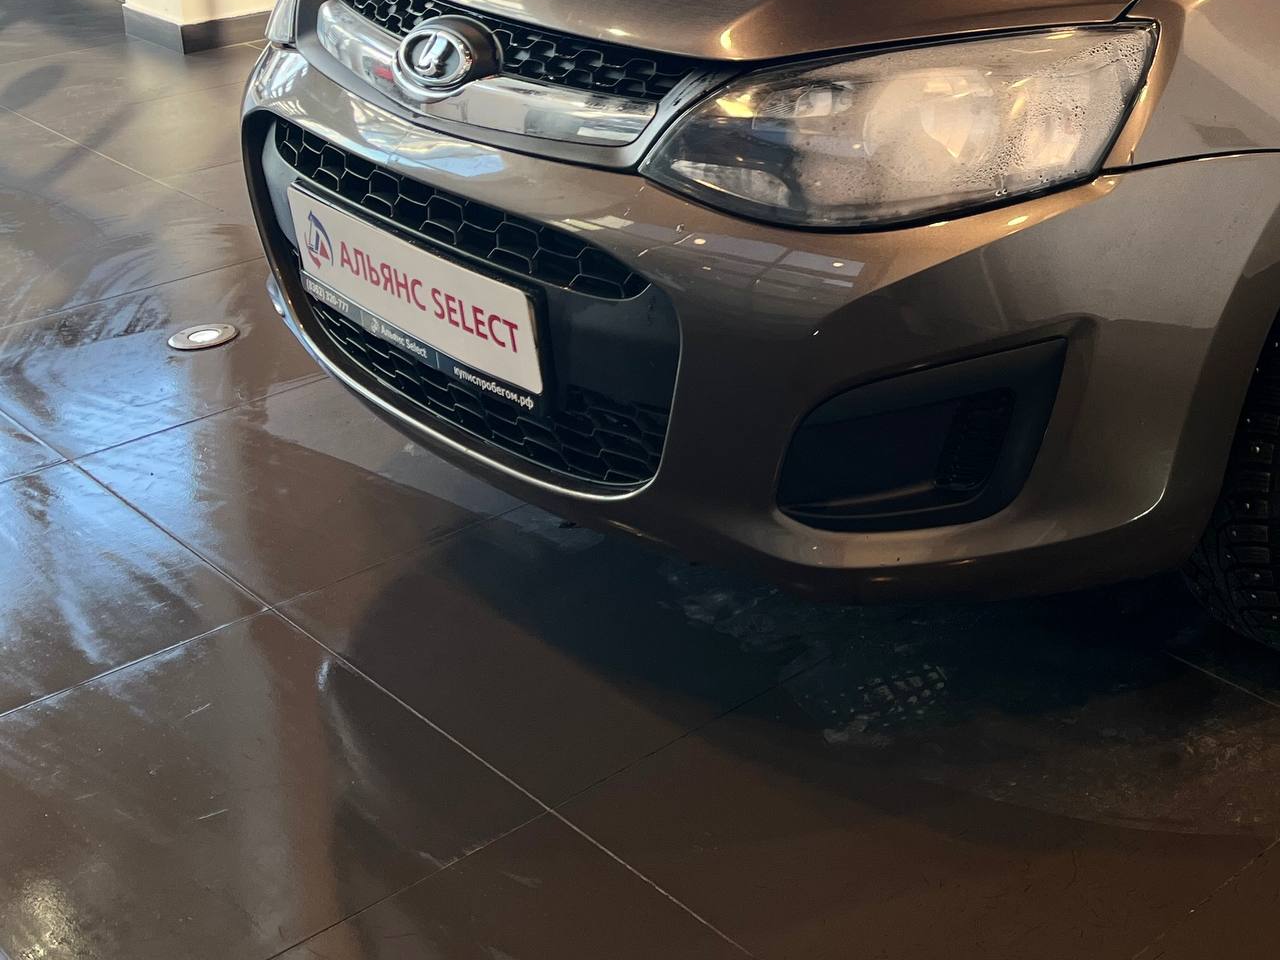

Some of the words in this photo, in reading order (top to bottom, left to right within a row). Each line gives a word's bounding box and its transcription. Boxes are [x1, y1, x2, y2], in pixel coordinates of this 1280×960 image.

[340, 241, 427, 312] АЛЬЯНС
[431, 287, 519, 354] SELECT
[453, 365, 534, 410] куписпробегом.рф
